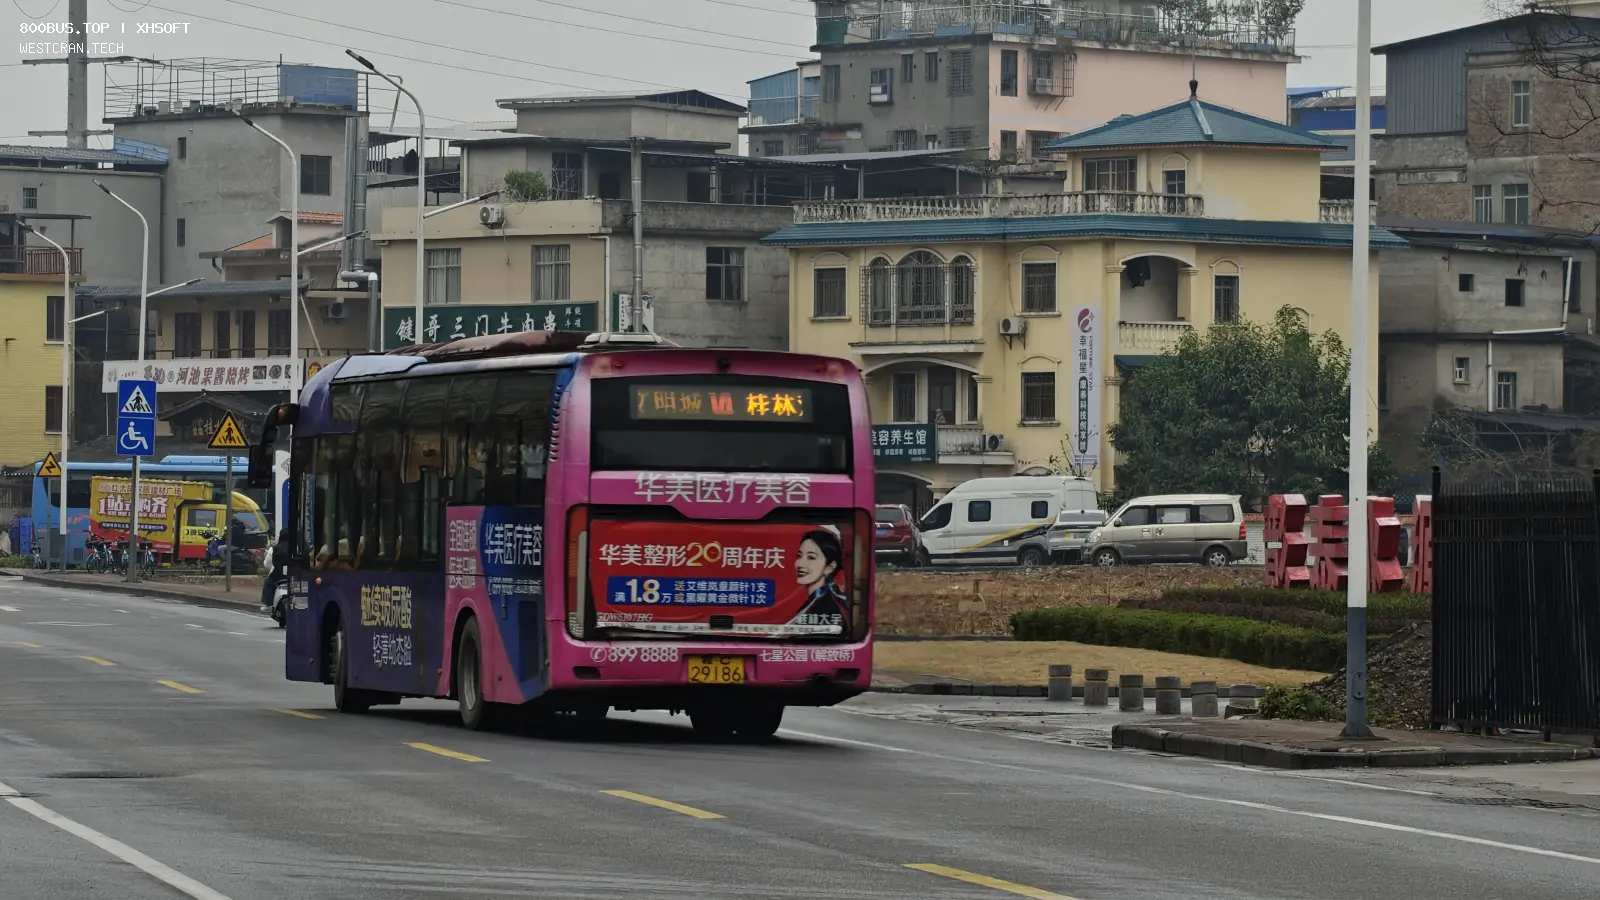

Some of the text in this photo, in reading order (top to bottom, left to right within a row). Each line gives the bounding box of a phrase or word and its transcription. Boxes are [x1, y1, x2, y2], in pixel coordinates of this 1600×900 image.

[634, 472, 811, 503] 华美医疗美容
[485, 523, 542, 565] 华美医疗美容
[598, 541, 786, 569] 华美整形20周年庆
[608, 646, 679, 662] 899 8888
[759, 649, 808, 662] 七星公园
[691, 666, 742, 682] 29186
